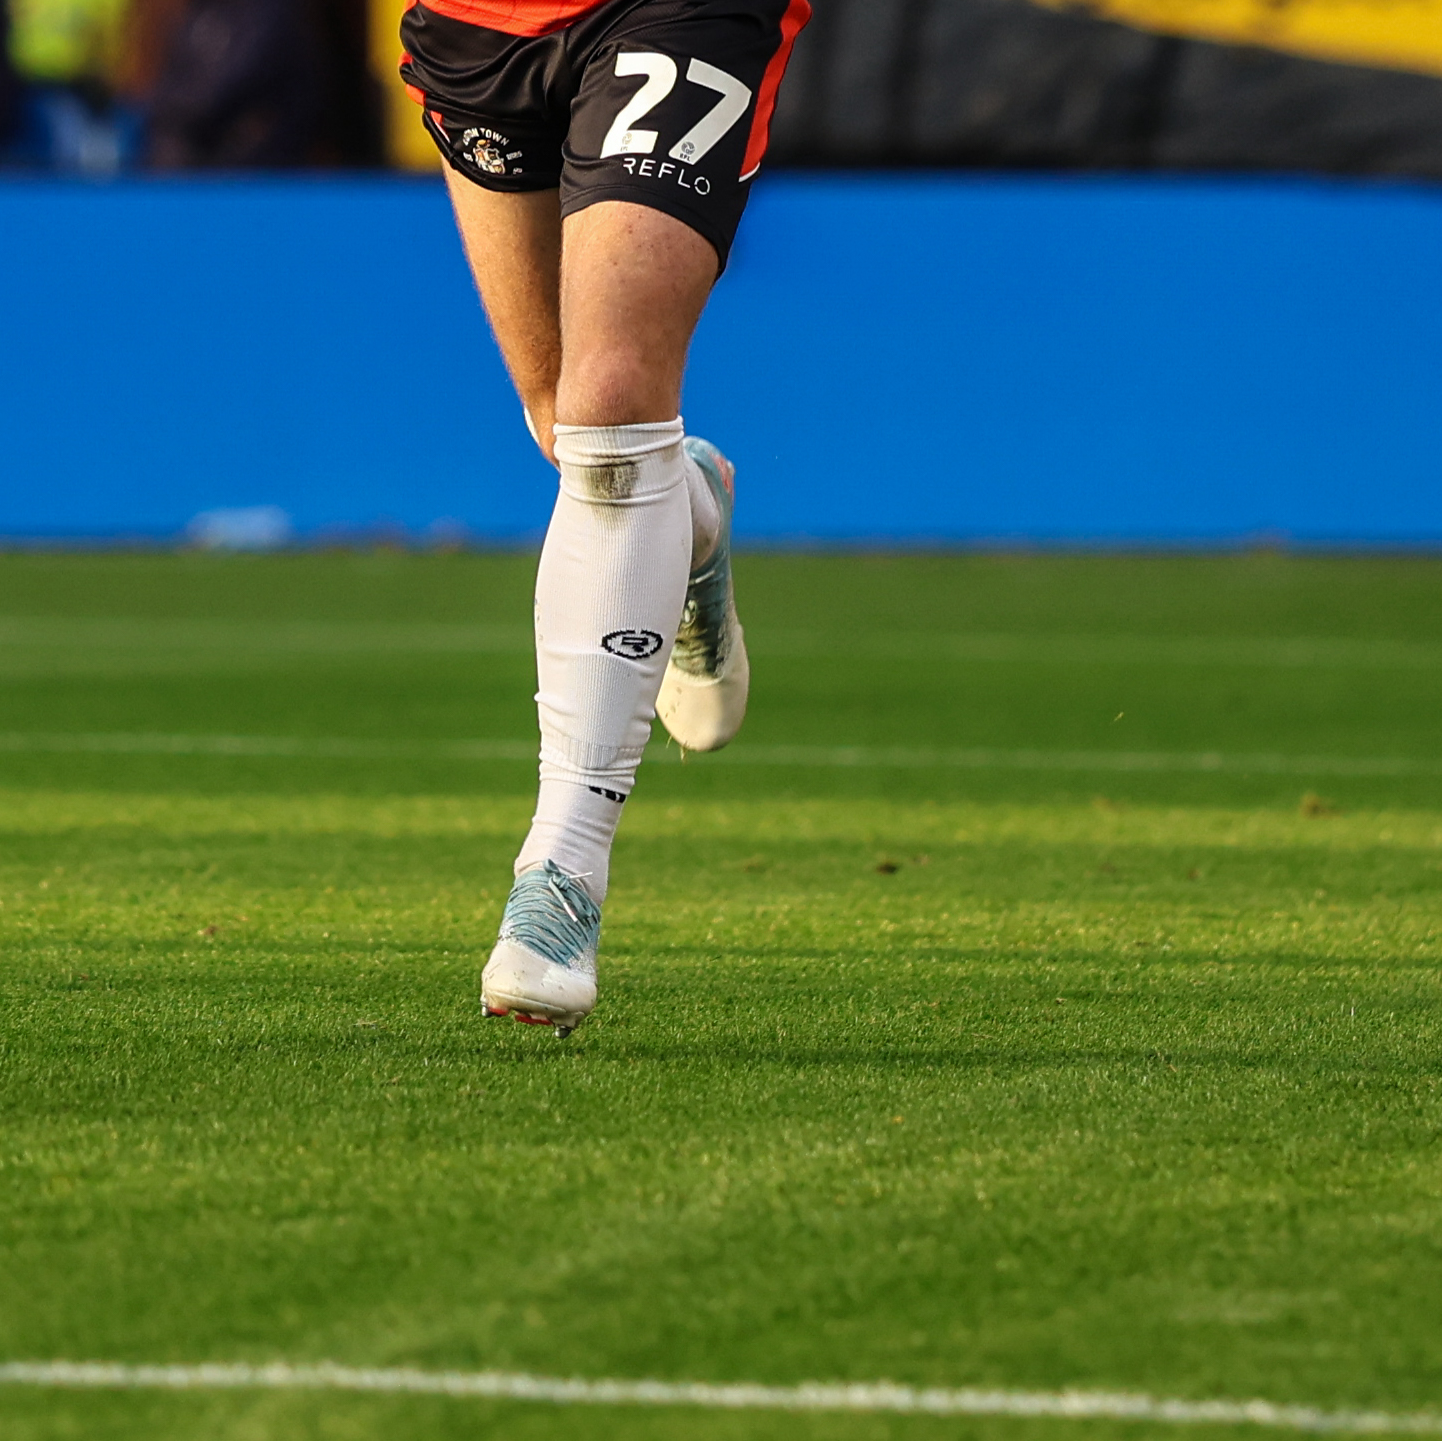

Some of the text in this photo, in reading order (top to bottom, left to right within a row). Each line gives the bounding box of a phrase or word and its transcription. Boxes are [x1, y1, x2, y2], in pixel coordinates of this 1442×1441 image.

[600, 52, 752, 165] 27
[480, 127, 510, 146] TOWN
[680, 153, 691, 162] EFL
[623, 157, 711, 195] REFLO
